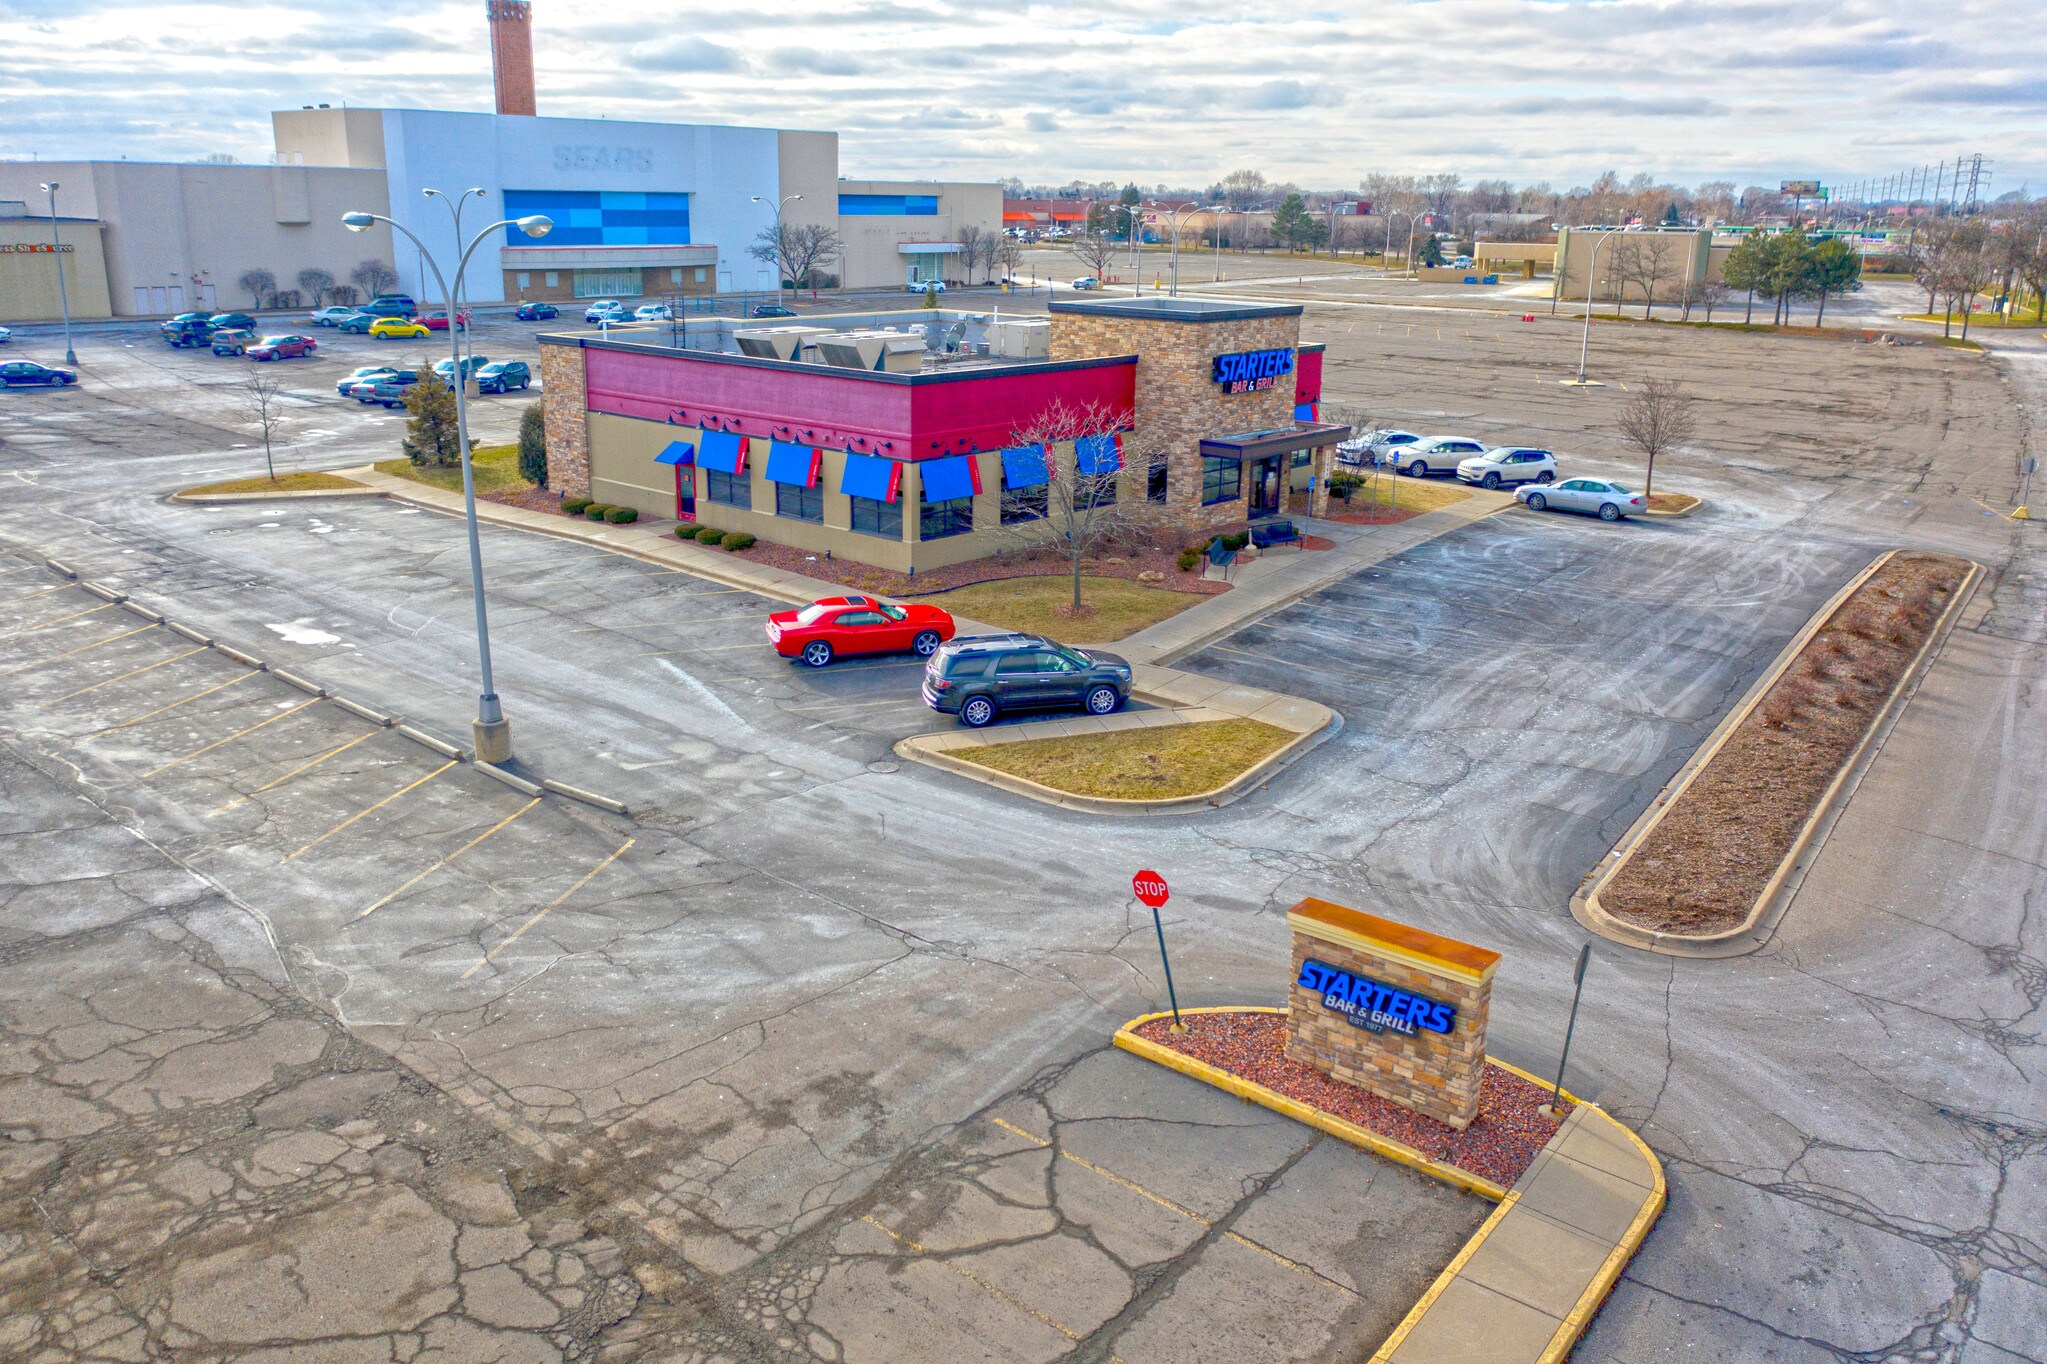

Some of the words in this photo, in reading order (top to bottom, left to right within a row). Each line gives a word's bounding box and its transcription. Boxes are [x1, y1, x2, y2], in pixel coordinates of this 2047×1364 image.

[553, 144, 653, 173] SEARS
[17, 243, 75, 253] ShoeSource
[462, 308, 472, 318] 25
[1217, 348, 1295, 383] STARTERS
[1231, 380, 1248, 394] BAR
[1248, 381, 1255, 391] &
[1135, 881, 1166, 896] STOP
[1297, 961, 1453, 1035] STARTERS
[1324, 994, 1356, 1015] BAR
[1358, 1007, 1367, 1018] &
[1370, 1010, 1414, 1035] GRILL
[1350, 1016, 1364, 1025] EST
[1366, 1022, 1383, 1033] 1977
